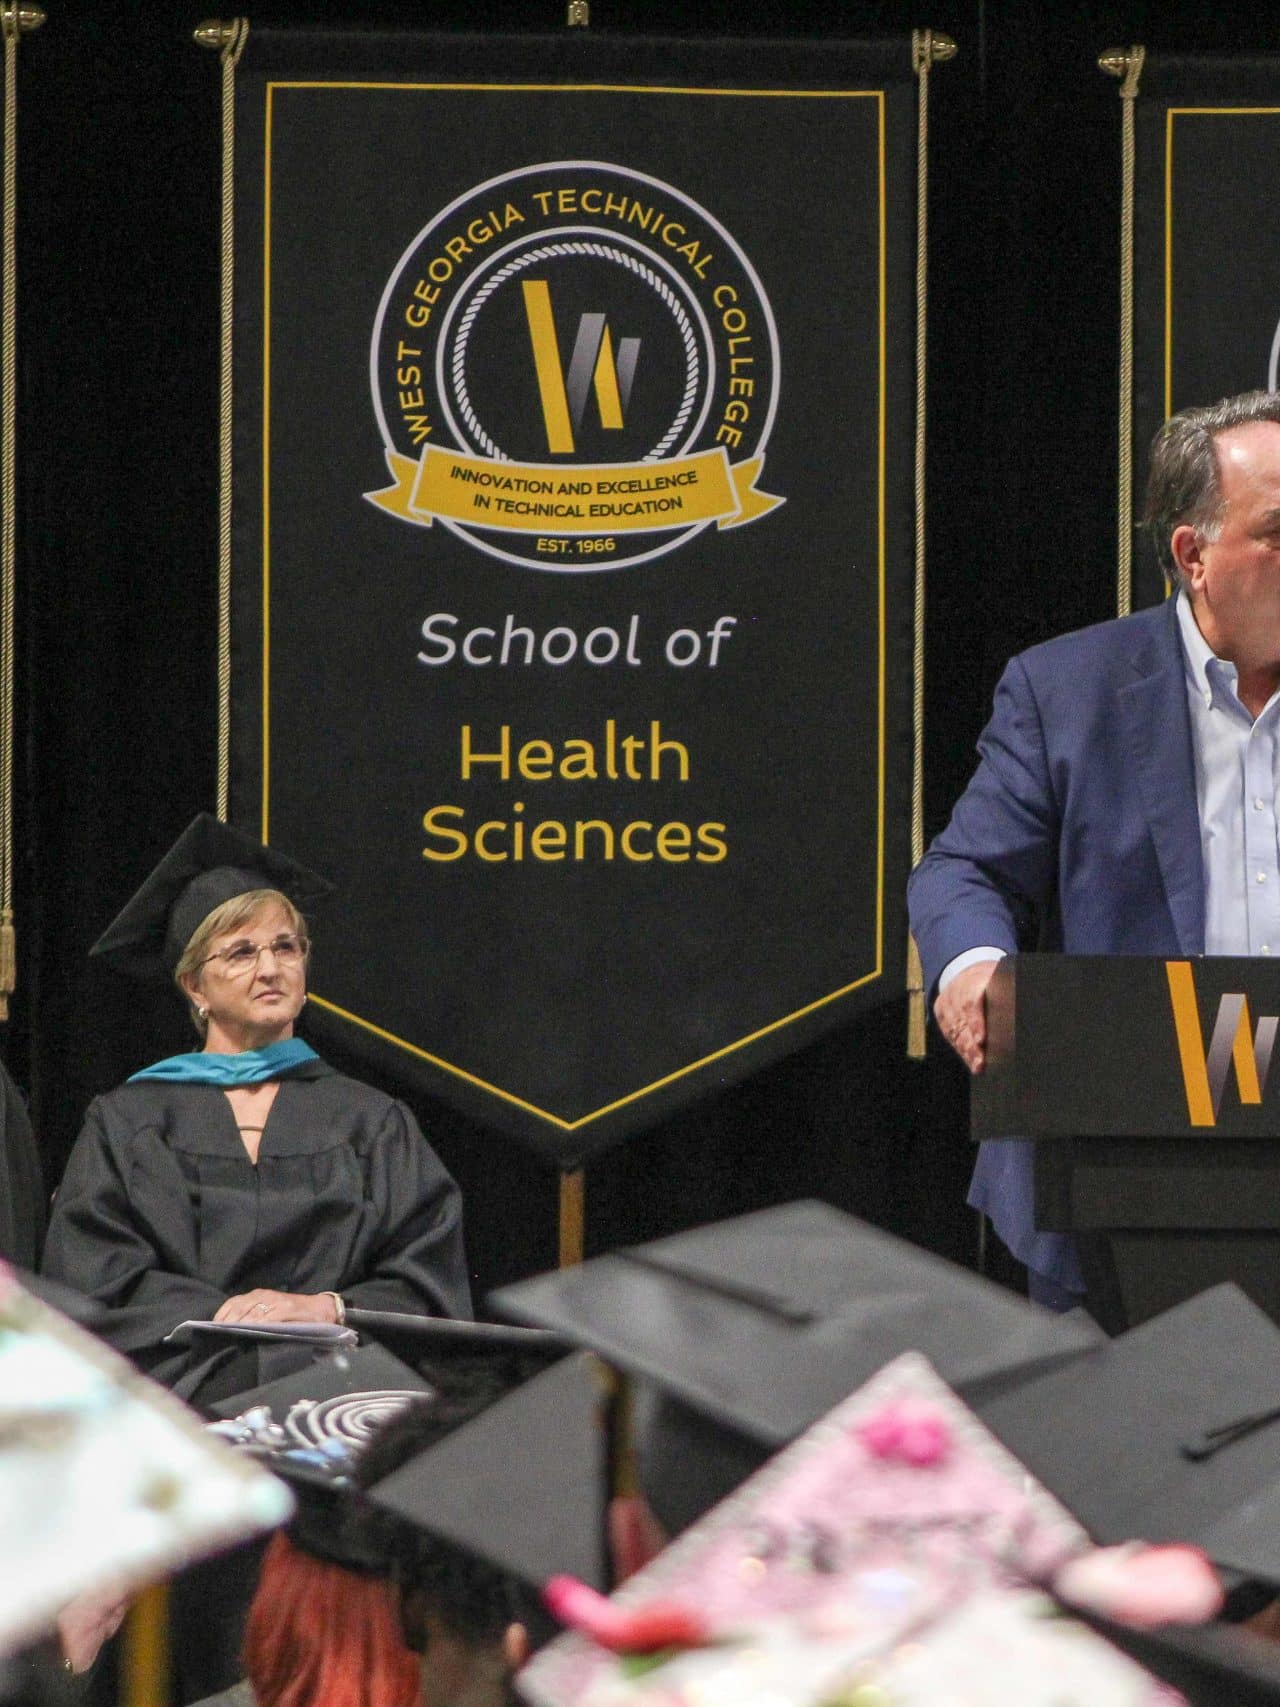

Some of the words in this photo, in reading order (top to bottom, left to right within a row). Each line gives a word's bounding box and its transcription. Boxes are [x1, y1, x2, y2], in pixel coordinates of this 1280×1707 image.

[405, 202, 525, 327] GEORGIA
[533, 189, 713, 279] TECHNICAL
[397, 341, 432, 444] WEST
[713, 285, 754, 447] COLLEGE
[450, 465, 553, 495] INNOVATION
[557, 480, 592, 495] AND
[596, 471, 698, 495] EXCELLENCE
[474, 494, 490, 510] IN
[495, 498, 585, 518] TECHNICAL
[589, 496, 683, 518] EDUCATION
[537, 538, 573, 553] EST.
[576, 538, 616, 553] 1966
[418, 613, 641, 665] School
[666, 616, 738, 666] of
[461, 719, 690, 781] Health
[422, 802, 728, 863] Sciences
